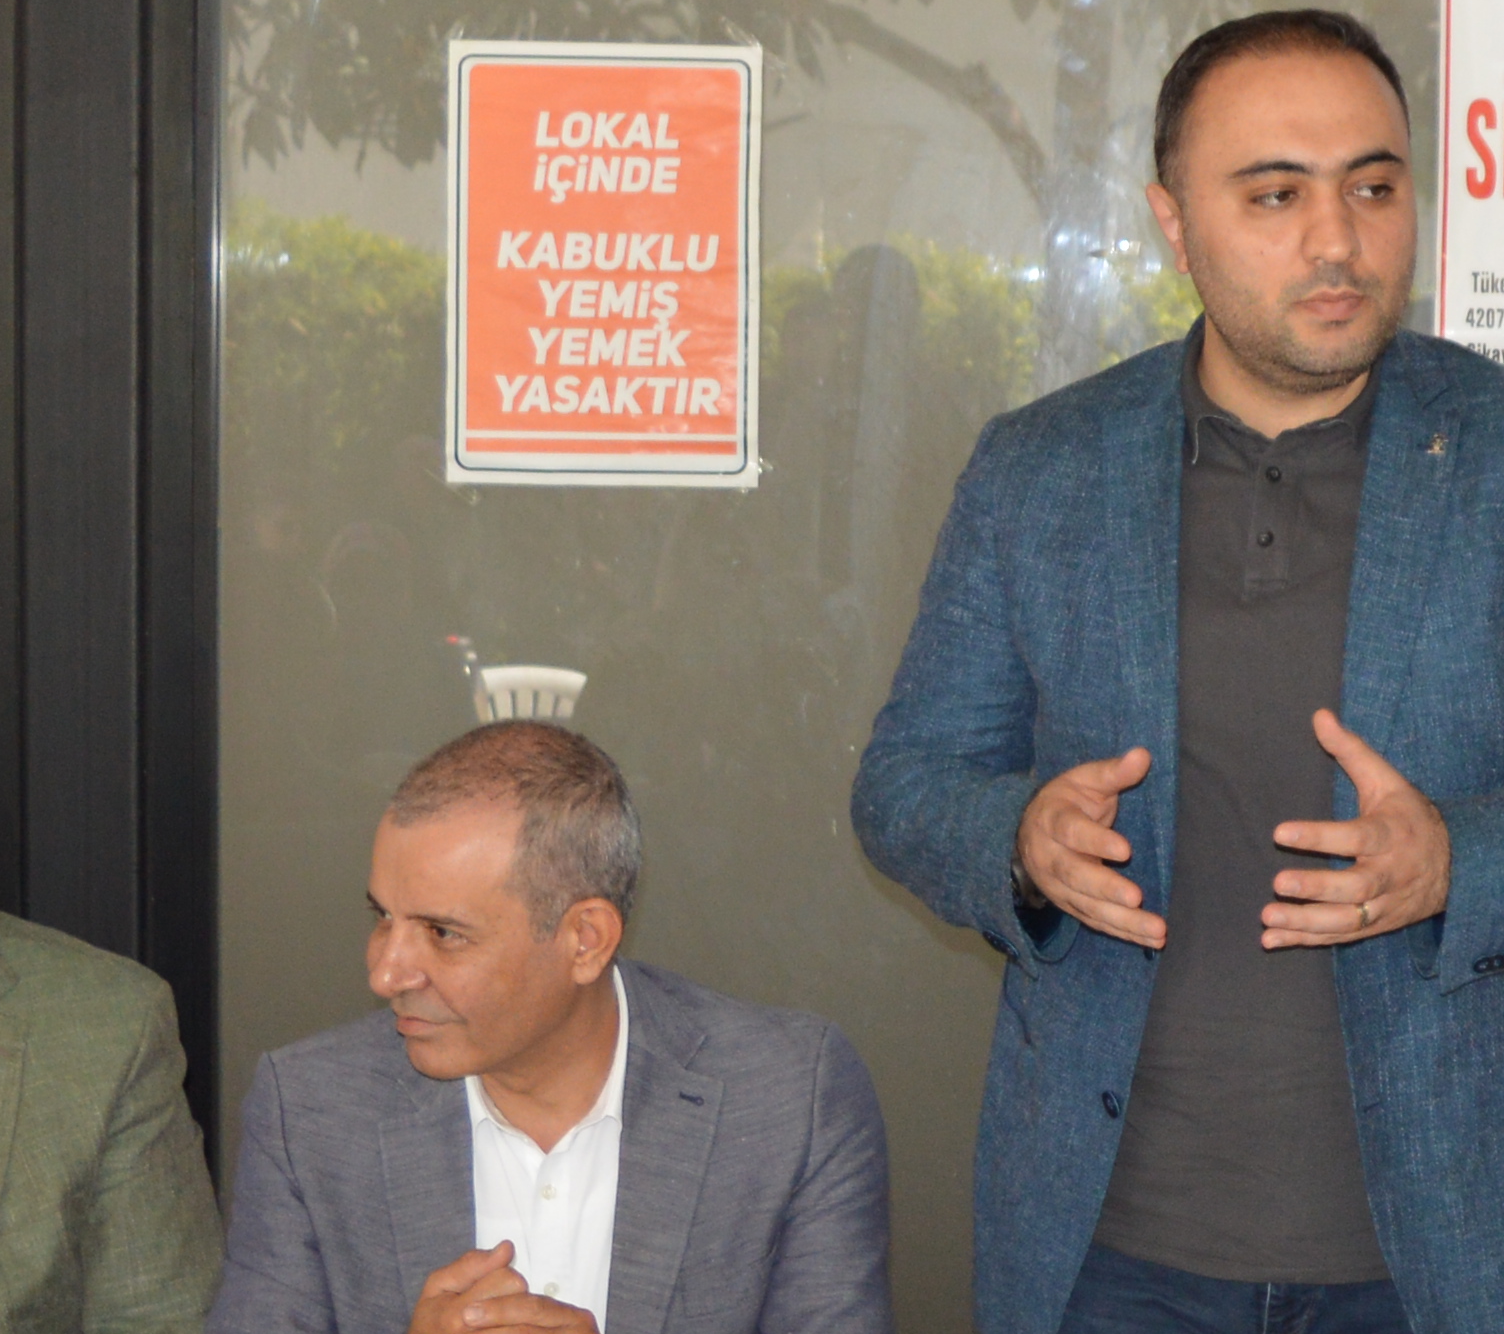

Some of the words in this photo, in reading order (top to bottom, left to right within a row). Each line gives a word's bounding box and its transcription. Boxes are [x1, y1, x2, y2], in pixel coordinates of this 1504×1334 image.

[535, 111, 679, 149] LOKAL
[533, 153, 681, 203] İÇİNDE
[497, 230, 719, 272] KABUKLU
[538, 279, 680, 331] YEMİŞ
[1465, 308, 1504, 329] 4207
[528, 326, 691, 366] YEMEK
[495, 374, 722, 416] YASAKTIR
